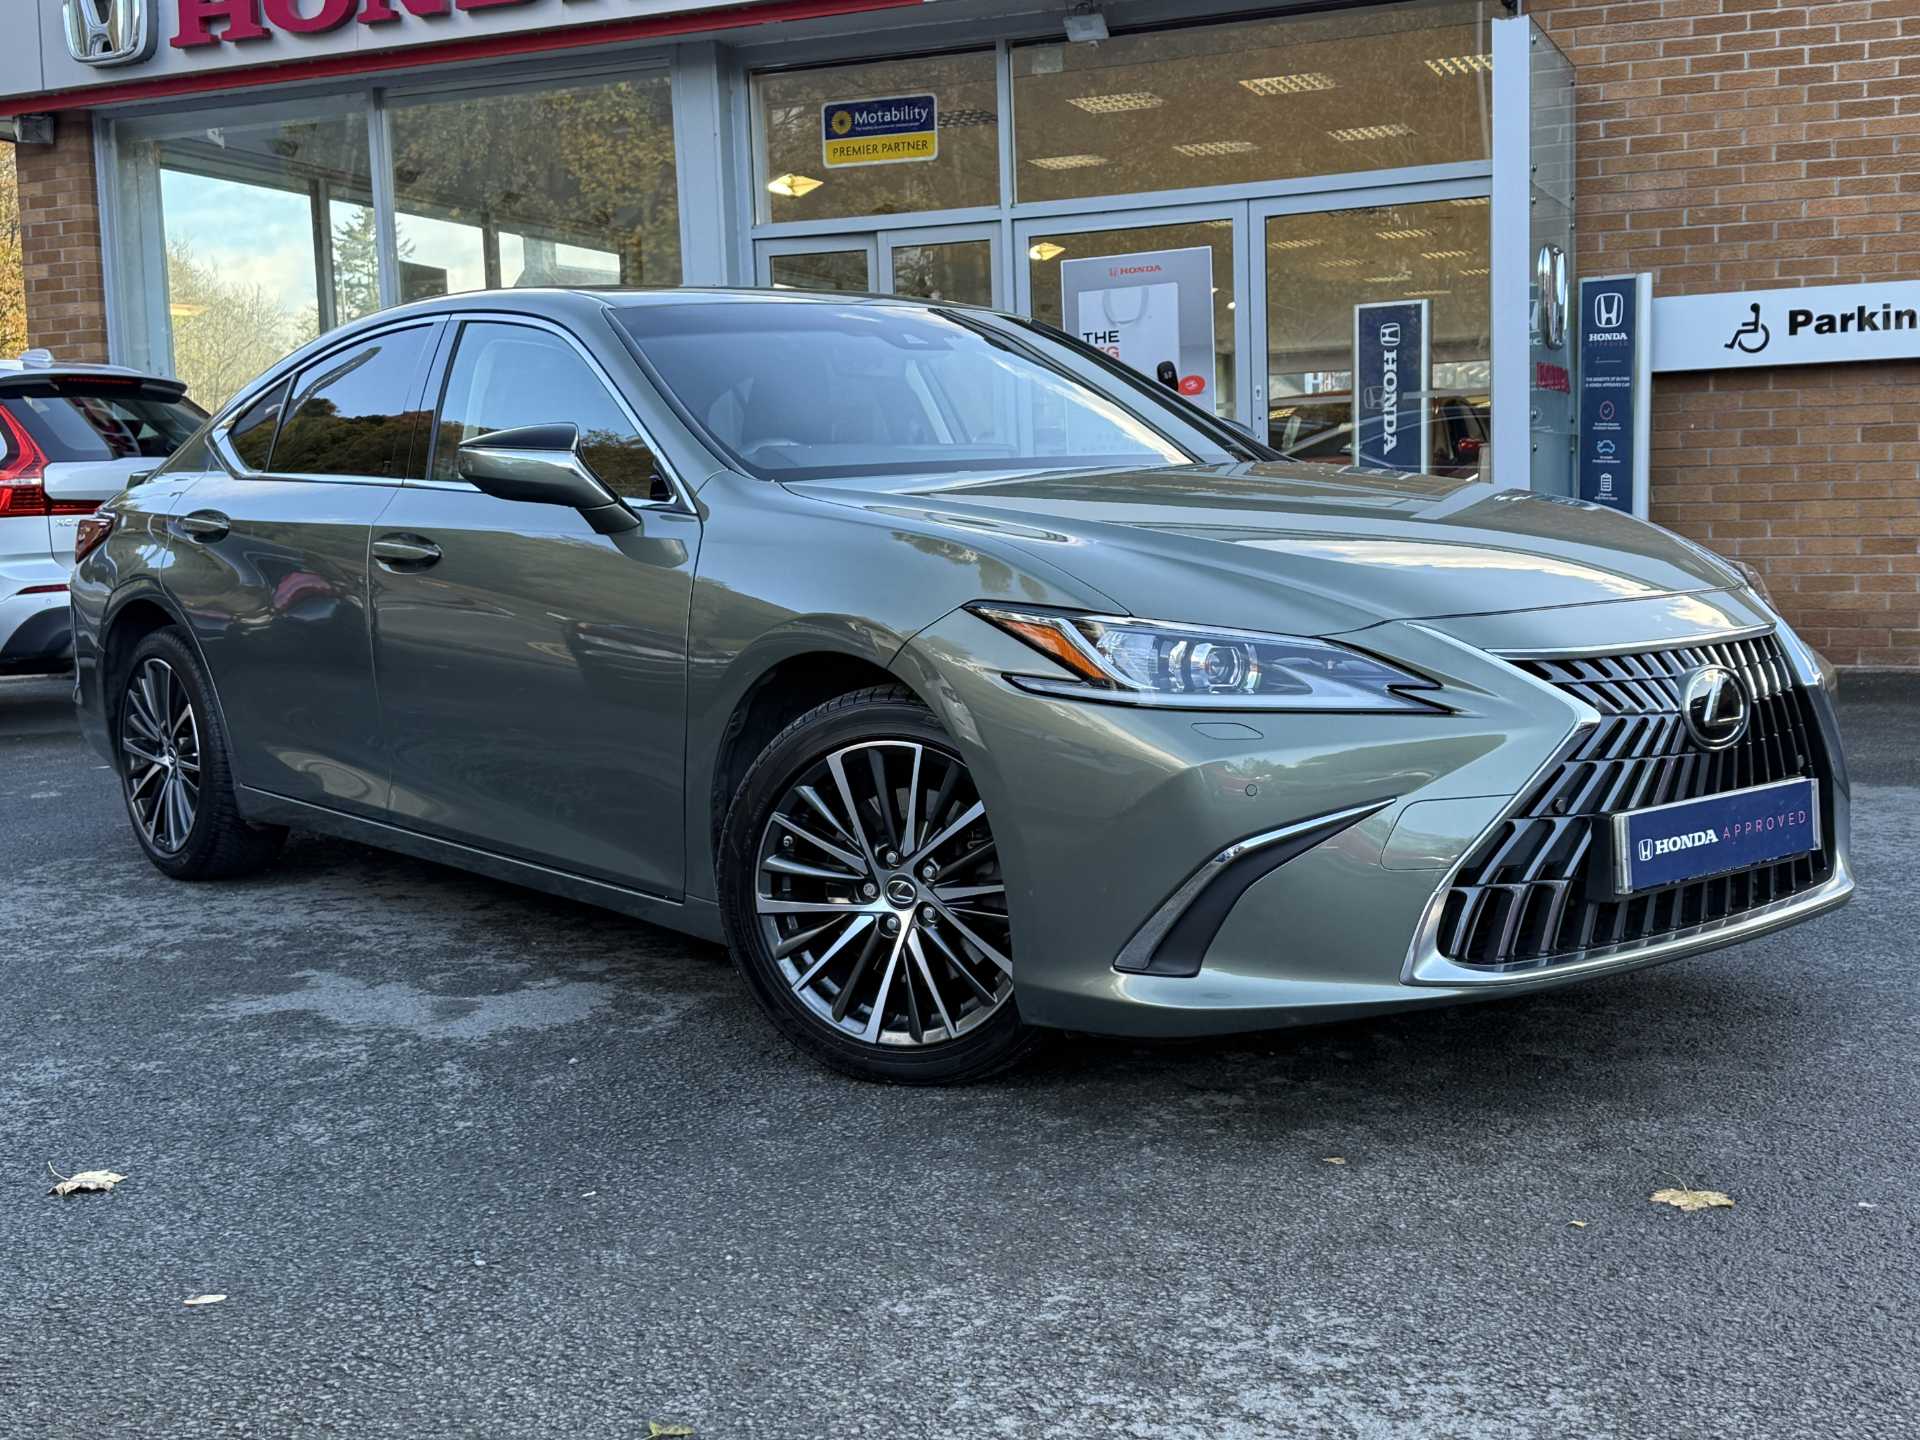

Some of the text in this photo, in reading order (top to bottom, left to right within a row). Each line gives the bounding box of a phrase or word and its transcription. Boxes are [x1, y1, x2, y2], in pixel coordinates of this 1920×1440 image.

[854, 105, 929, 125] Motability
[832, 139, 929, 158] PREMIER PARTNER
[1119, 264, 1163, 276] HONDA
[1788, 303, 1920, 337] Parkin
[1082, 329, 1121, 344] THE
[1588, 332, 1628, 342] HONDA
[1383, 349, 1398, 456] HONDA
[1655, 829, 1720, 855] HONDA
[1723, 810, 1807, 840] APPROVED
